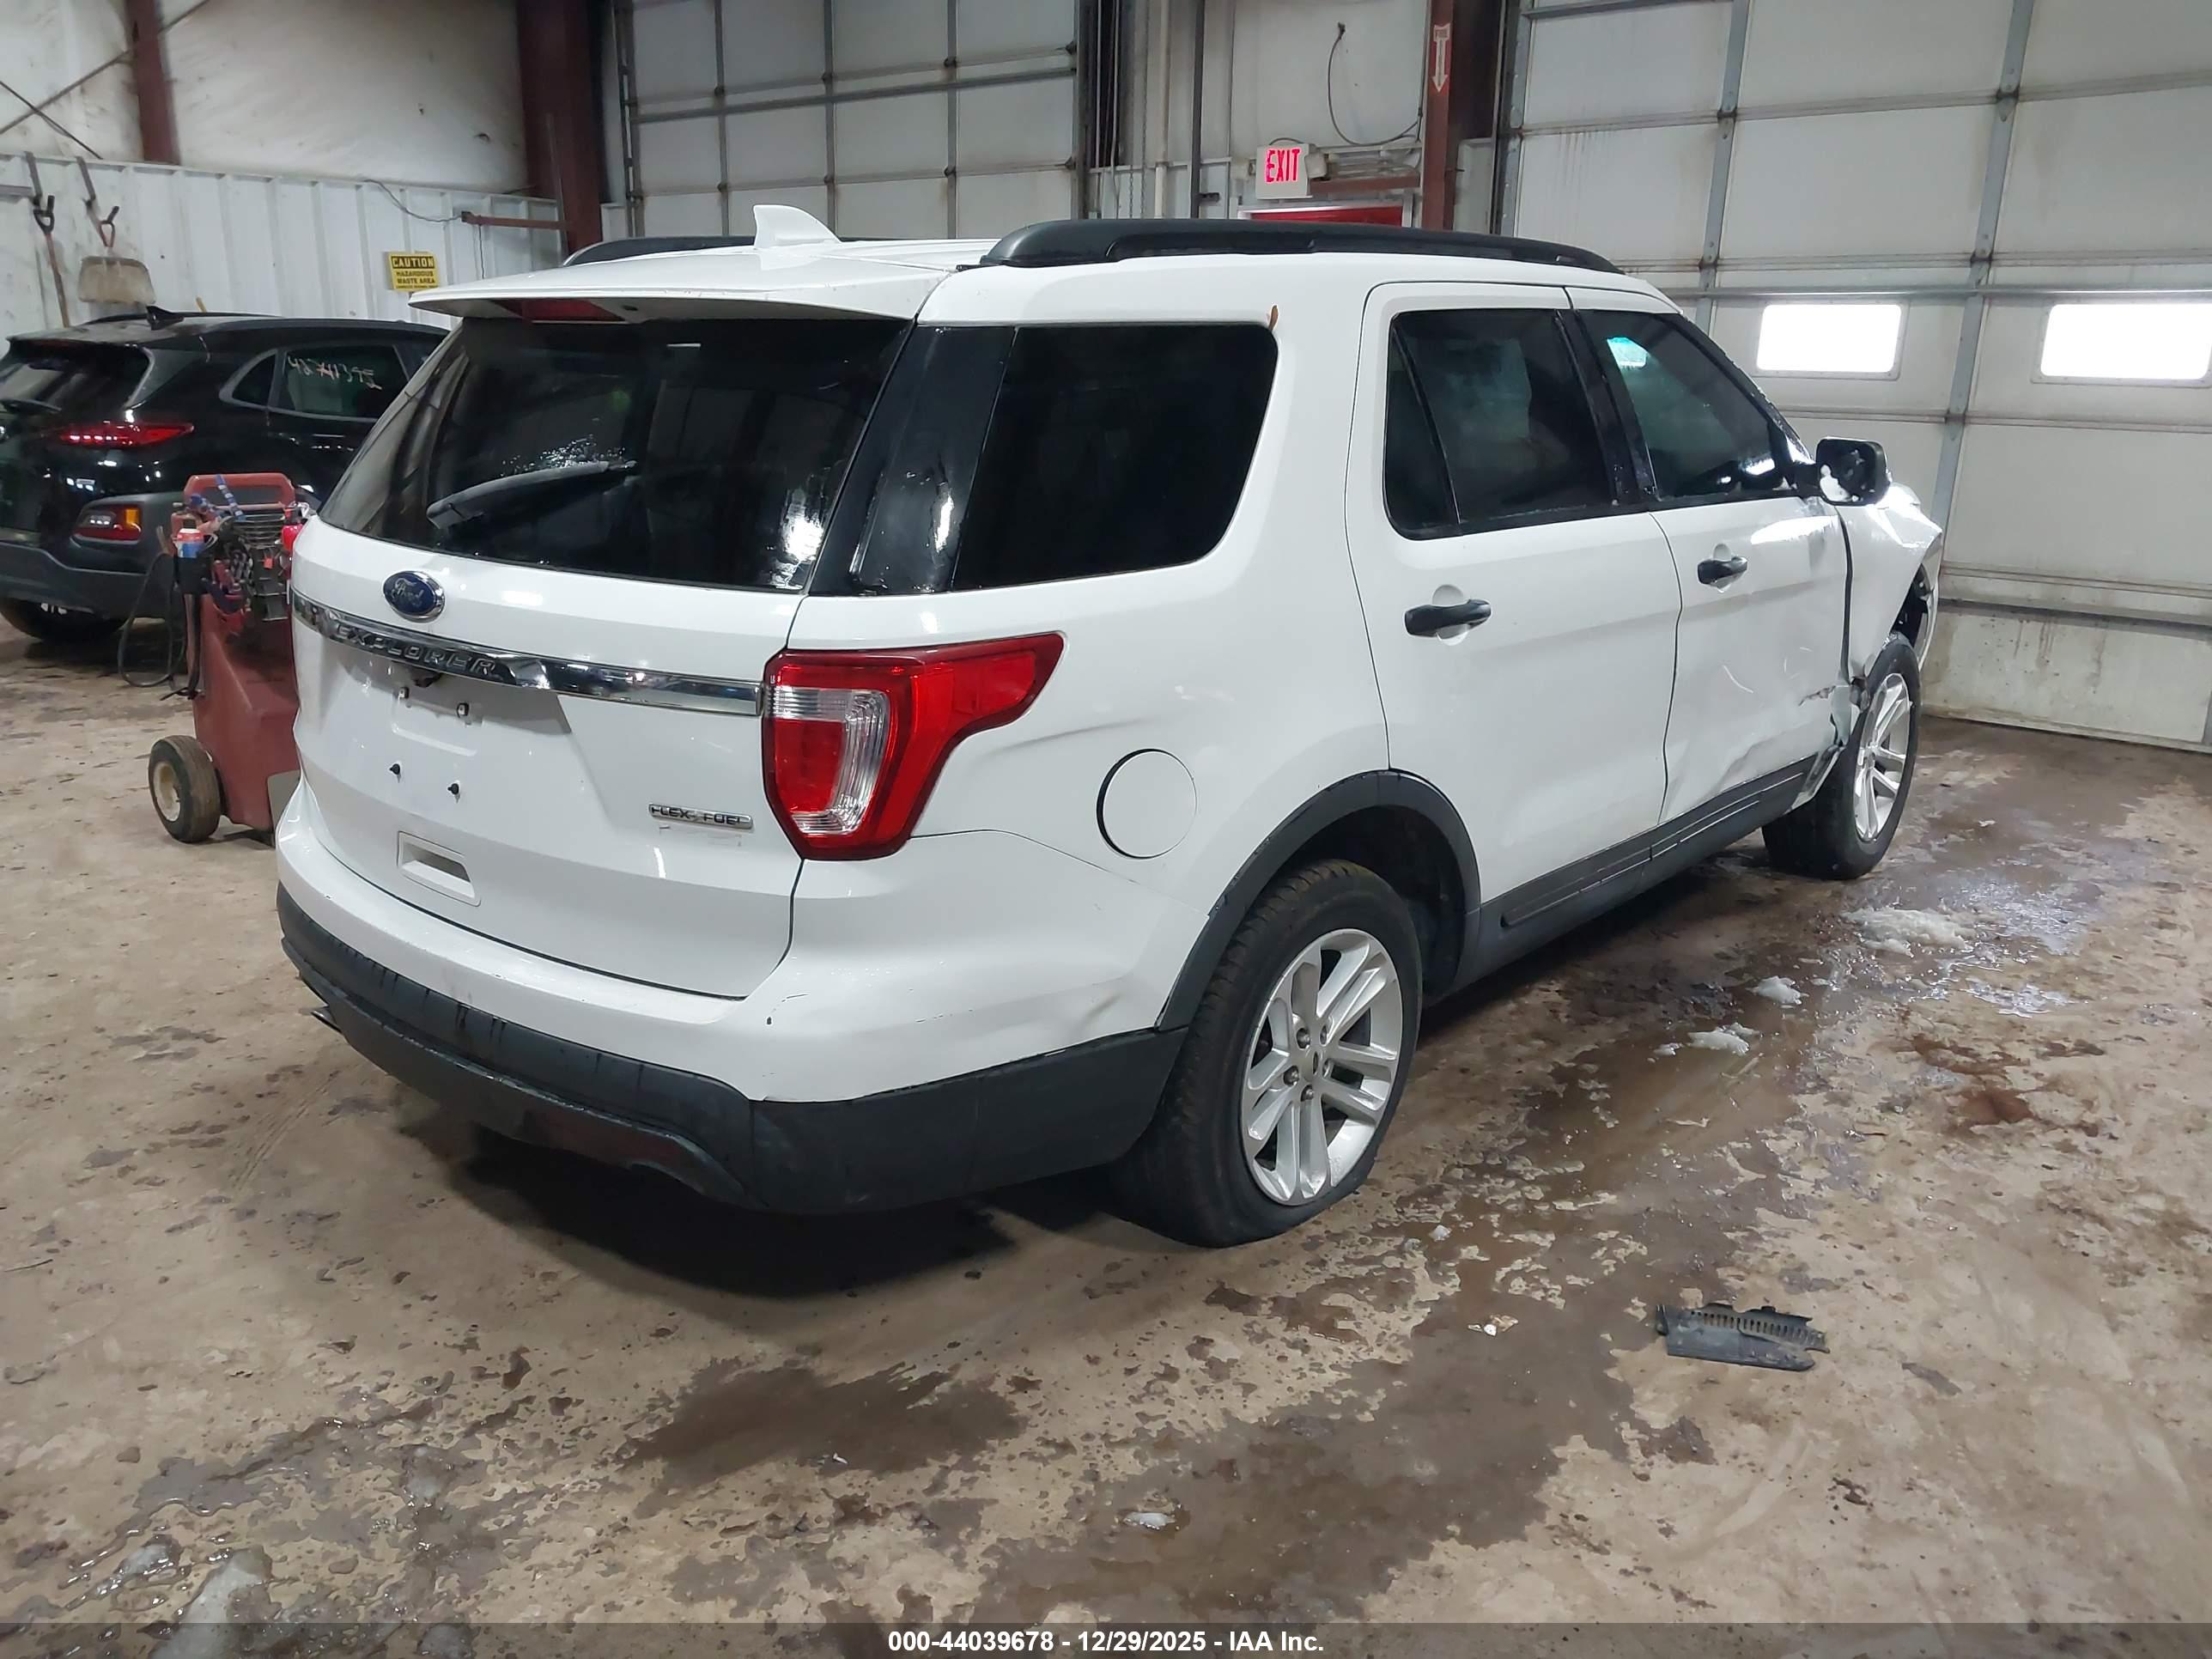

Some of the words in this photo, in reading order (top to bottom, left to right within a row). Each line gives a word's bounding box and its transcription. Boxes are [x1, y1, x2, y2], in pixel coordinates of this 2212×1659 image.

[1266, 149, 1300, 182] EXIT
[392, 258, 434, 267] CAUTION
[333, 623, 495, 675] EXPLORER
